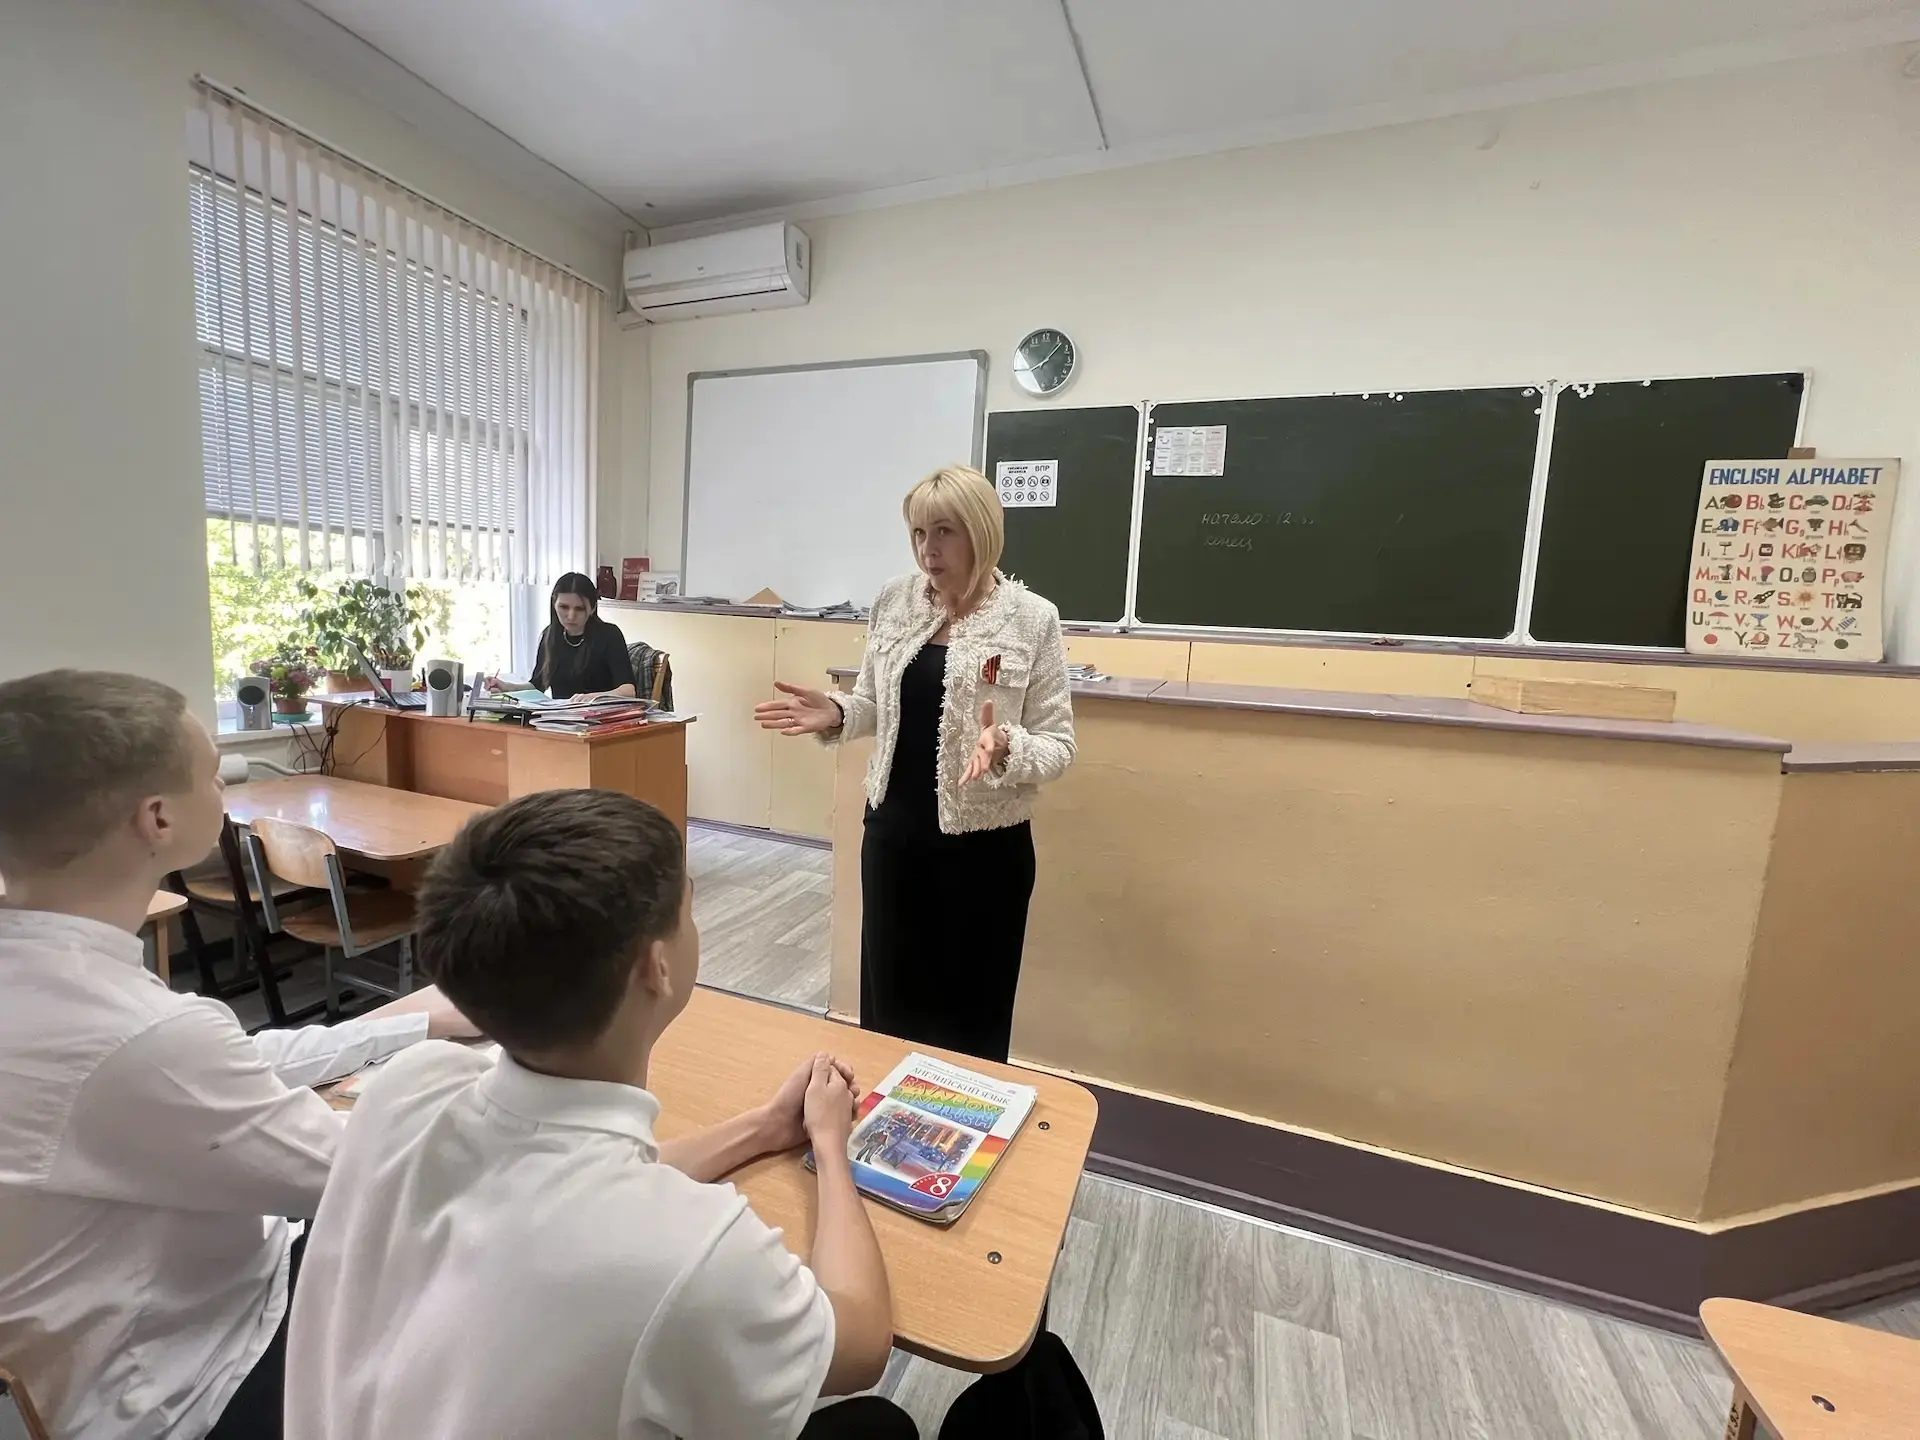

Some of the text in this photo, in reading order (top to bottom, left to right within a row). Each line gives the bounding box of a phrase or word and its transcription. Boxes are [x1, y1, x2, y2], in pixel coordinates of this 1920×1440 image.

[1709, 467, 1883, 485] ENGLISH ALPHABET
[912, 1067, 980, 1095] АНГЛИЙСКИЙ
[981, 1090, 1011, 1105] ЯЗЫК
[929, 1176, 952, 1196] 8
